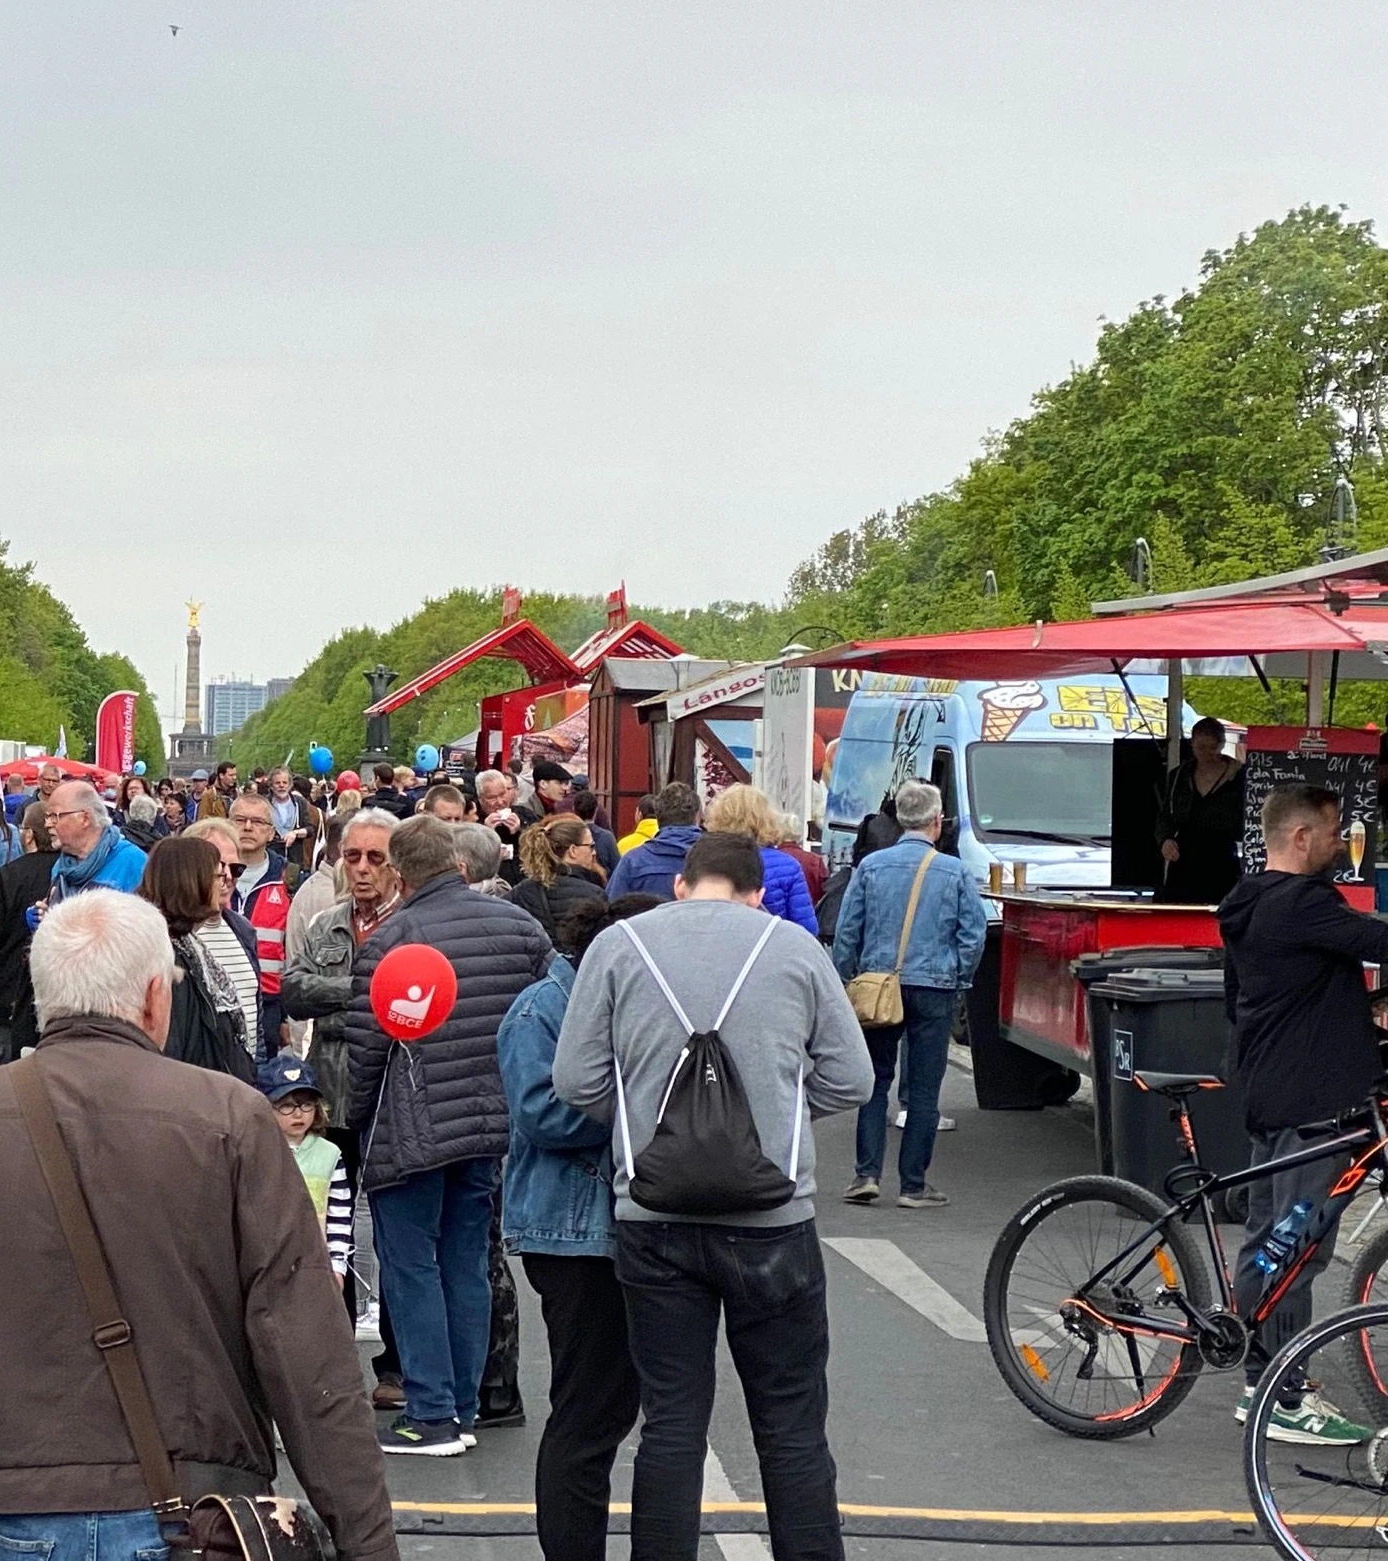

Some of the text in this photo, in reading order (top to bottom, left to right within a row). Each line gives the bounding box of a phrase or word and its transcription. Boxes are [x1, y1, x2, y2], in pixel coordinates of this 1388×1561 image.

[1248, 752, 1273, 767] Pils
[1246, 766, 1306, 780] Cola Fanta
